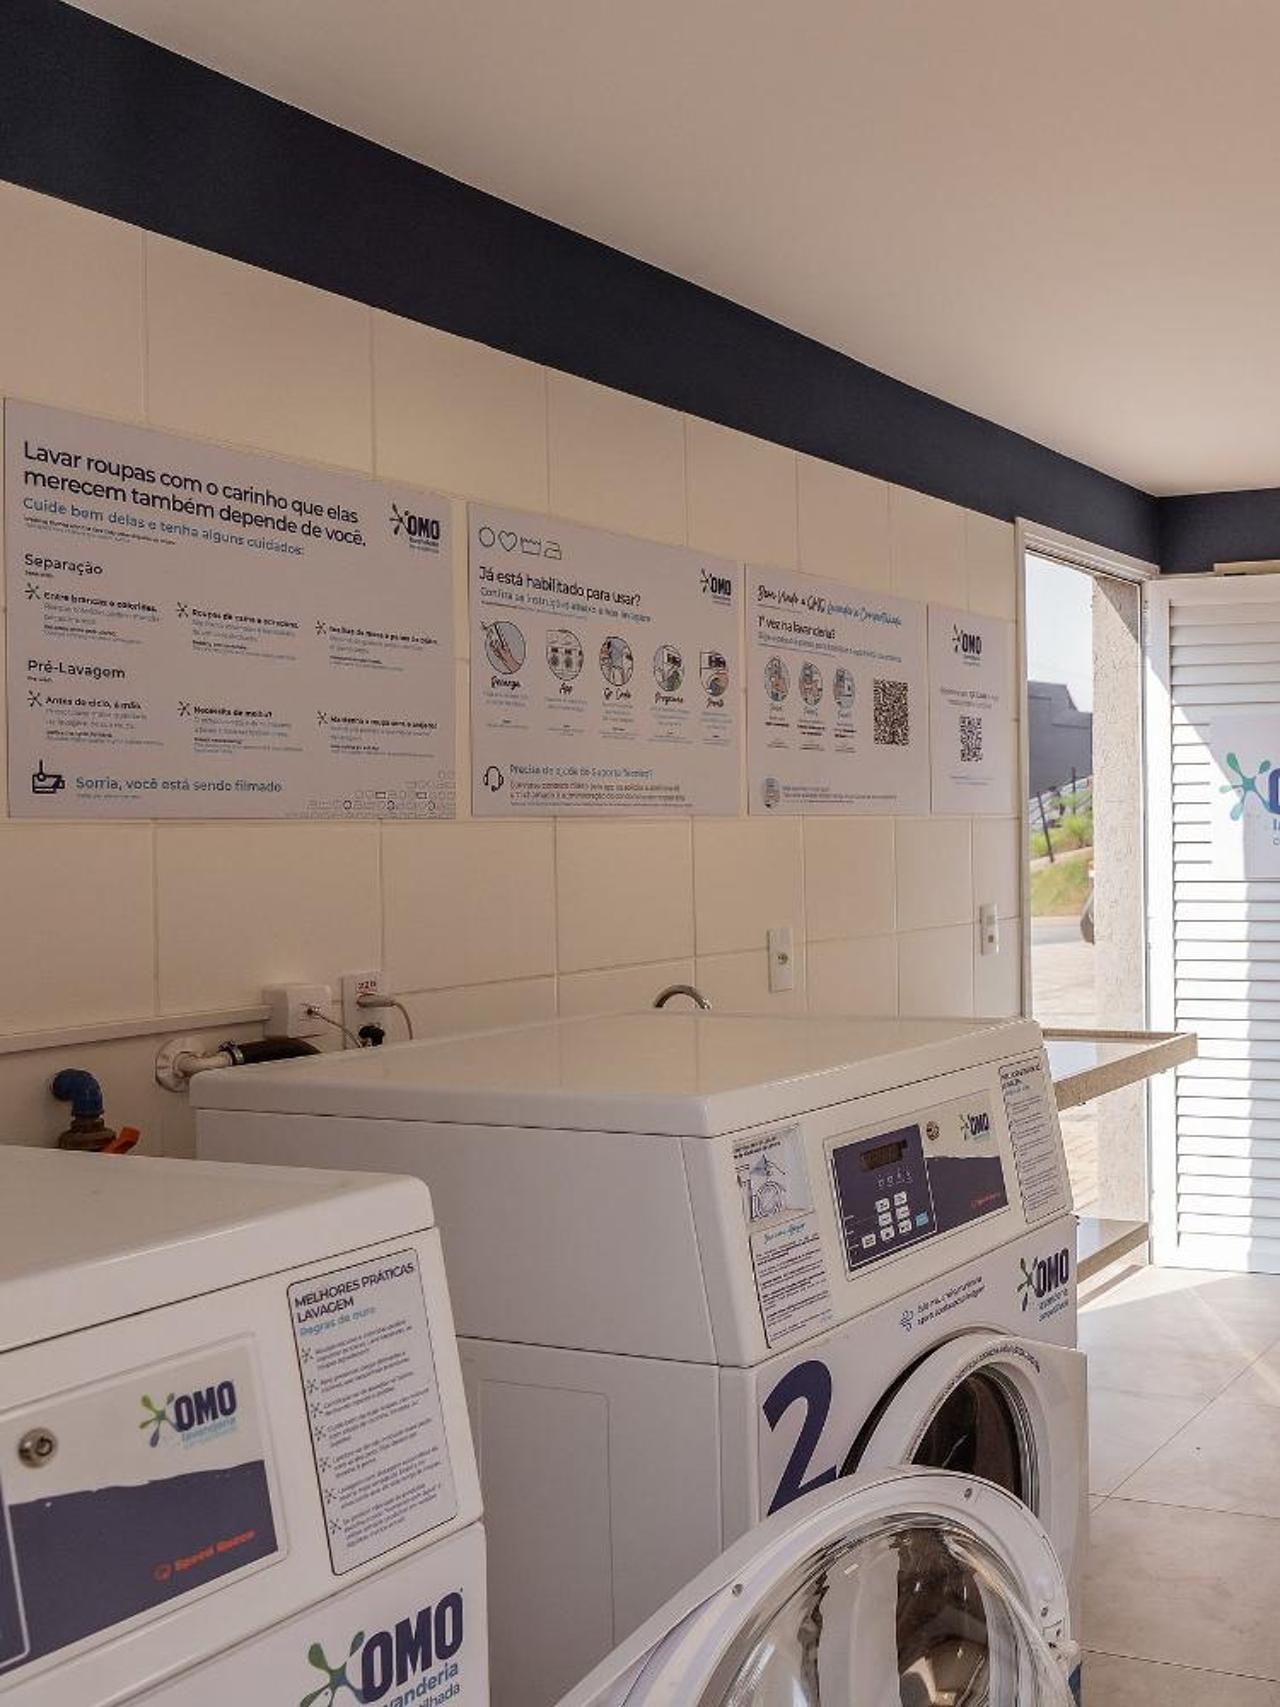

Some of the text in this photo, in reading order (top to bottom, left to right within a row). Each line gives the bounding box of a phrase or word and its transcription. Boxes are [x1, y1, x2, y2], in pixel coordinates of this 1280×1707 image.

[24, 440, 358, 523] Lavar roupas com o carinho que elas
[23, 497, 67, 514] Cuide
[70, 504, 103, 521] bem
[108, 511, 144, 527] delas
[160, 521, 198, 536] tenha
[202, 528, 244, 545] alguns
[24, 470, 366, 546] merecem também depende de você.
[407, 515, 439, 540] OMO
[24, 553, 103, 576] Separação
[479, 566, 641, 607] Já está habilitado para usar?
[711, 577, 731, 596] OMO
[961, 633, 982, 655] OMO
[28, 659, 126, 680] Pré-Lavagem
[75, 776, 281, 793] Sorria, você está sendo filmado
[294, 1262, 416, 1308] MELHORES PRÁTICAS
[1034, 1248, 1069, 1298] OMO
[297, 1296, 355, 1324] LAVAGEM
[175, 1380, 237, 1432] OMO
[762, 1359, 837, 1517] 2
[362, 1591, 464, 1704] OMO
